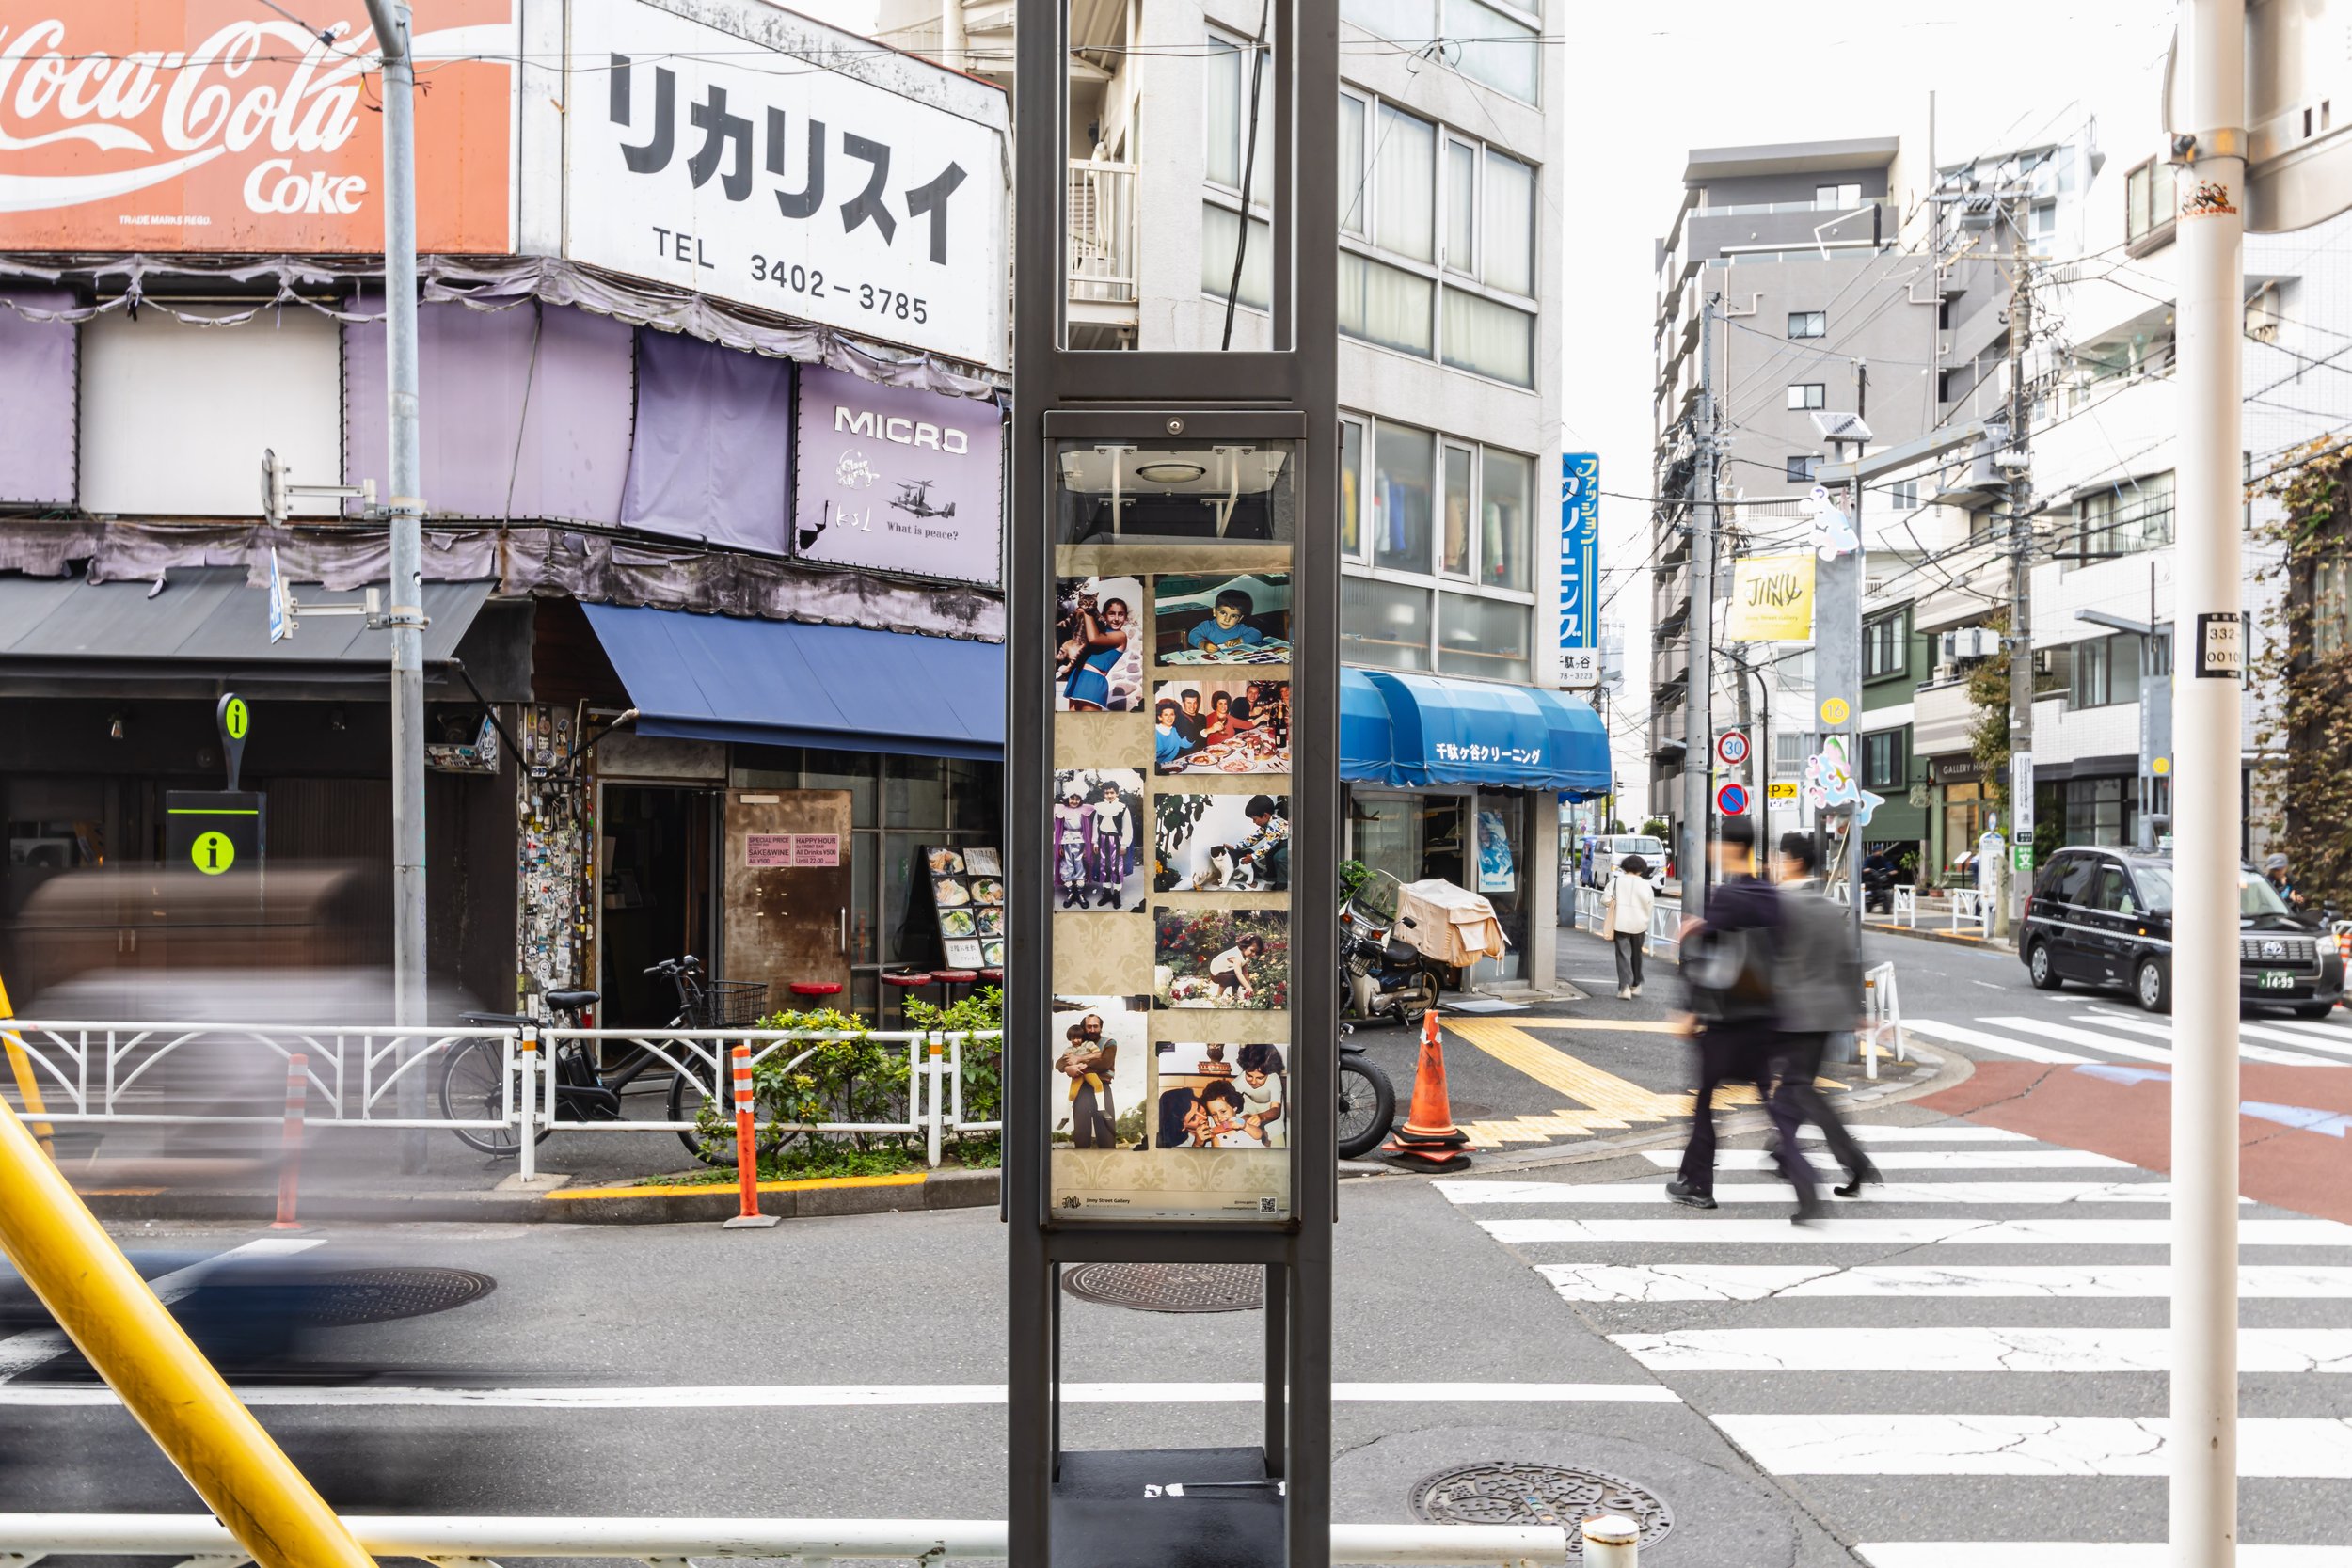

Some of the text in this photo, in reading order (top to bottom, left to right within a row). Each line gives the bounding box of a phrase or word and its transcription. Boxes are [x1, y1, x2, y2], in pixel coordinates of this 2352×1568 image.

[610, 52, 968, 266] リカリスイ
[244, 159, 367, 214] Coke
[119, 215, 150, 225] TRADE
[151, 215, 182, 225] MARKS
[653, 226, 928, 325] TEL 3402-3785
[834, 405, 968, 455] MICRO
[1576, 459, 1597, 545] ファッション
[887, 520, 959, 541] What is peace?
[1826, 705, 1844, 718] 16
[1724, 741, 1742, 755] 30
[1943, 764, 1971, 774] GALLERY
